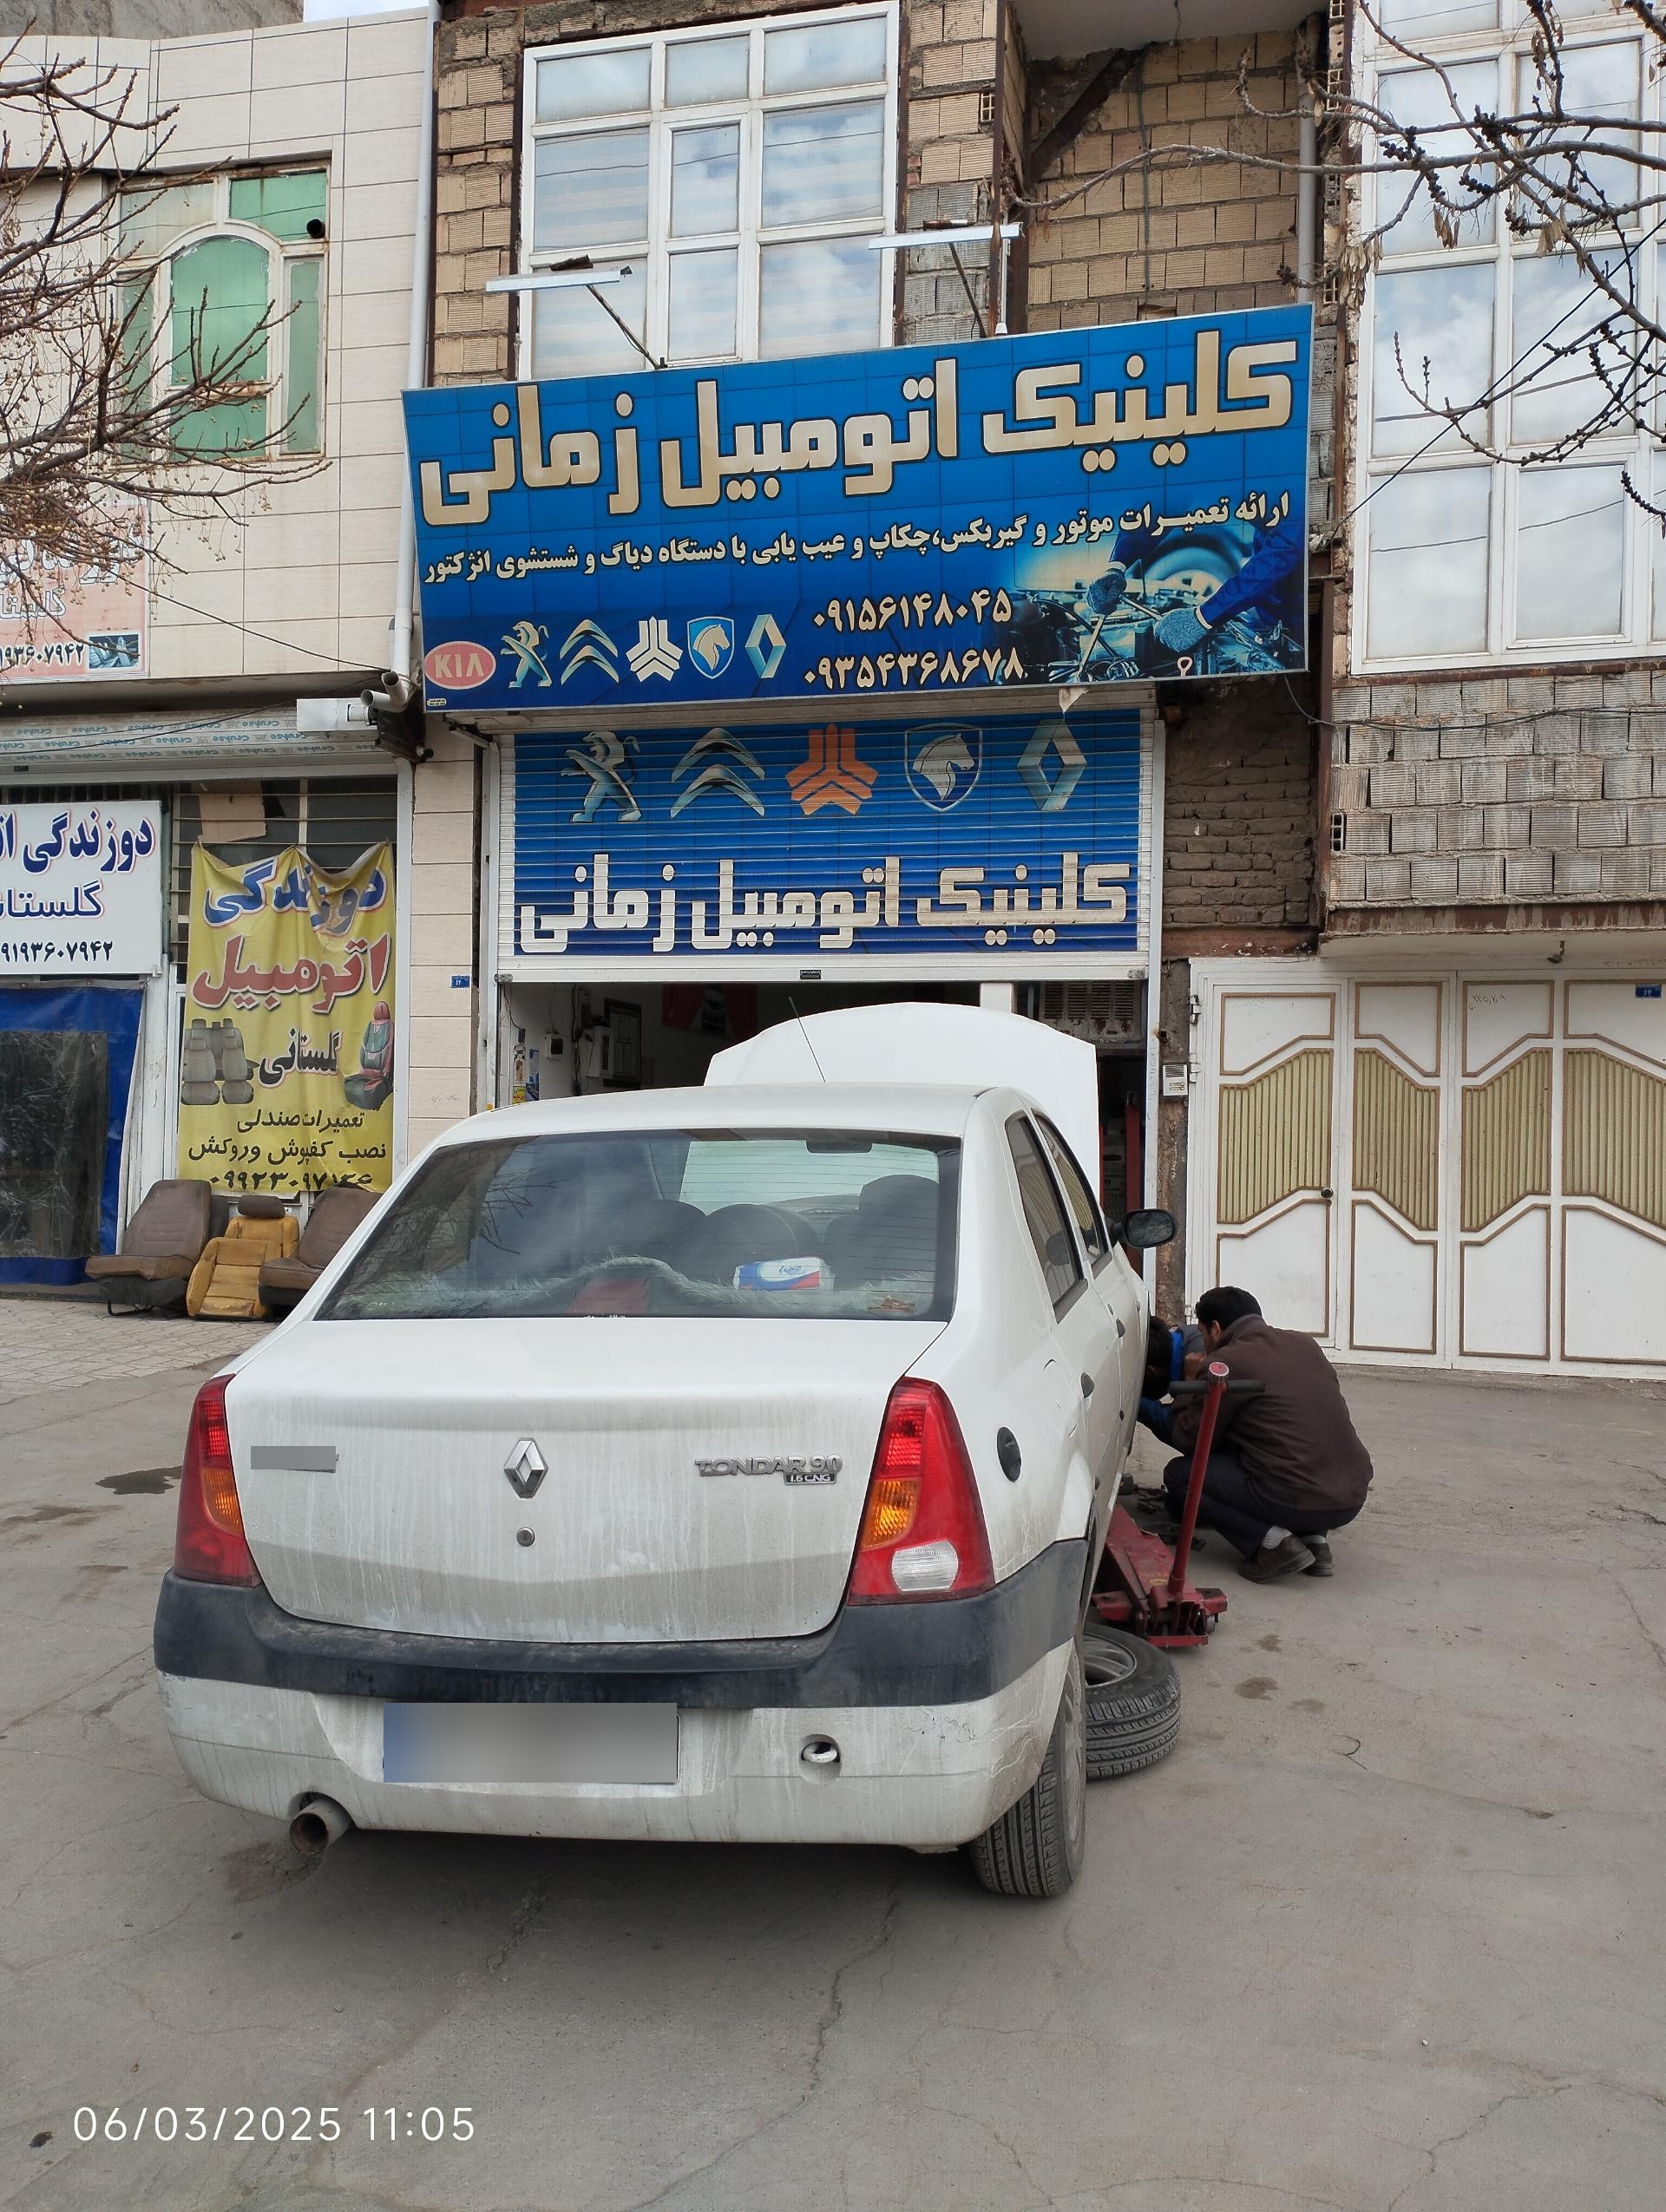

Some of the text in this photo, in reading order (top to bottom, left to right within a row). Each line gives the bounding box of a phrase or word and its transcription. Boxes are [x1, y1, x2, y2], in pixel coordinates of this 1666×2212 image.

[420, 330, 1296, 526] کلینیک اتومبیل زمانی
[1236, 491, 1289, 527] ارائه
[1033, 522, 1046, 546] و
[1052, 509, 1114, 543] موتور
[496, 545, 579, 579] شستشوی
[600, 541, 653, 570] دیاگ
[659, 536, 726, 563] دستگاه
[731, 534, 746, 565] با
[752, 532, 796, 565] یابی
[802, 533, 846, 561] عیب
[851, 537, 863, 560] و
[584, 552, 595, 574] و
[813, 589, 1012, 632] ۰۹۱۵۶۱۴۸۰۴۵
[434, 651, 484, 678] KIA
[804, 646, 1024, 690] ۰۹۳۵۴۳۶۸۶۷۸
[23, 809, 154, 873] دوزندگی
[521, 852, 1131, 952] کلینیک اتومبیل زمانی
[192, 933, 389, 1011] اتومبیل
[259, 1028, 341, 1085] گلستانی
[237, 1109, 300, 1133] صندلی
[267, 1139, 334, 1165] کفپوش
[338, 1142, 387, 1164] نصب
[695, 1454, 843, 1476] TONDAR 90
